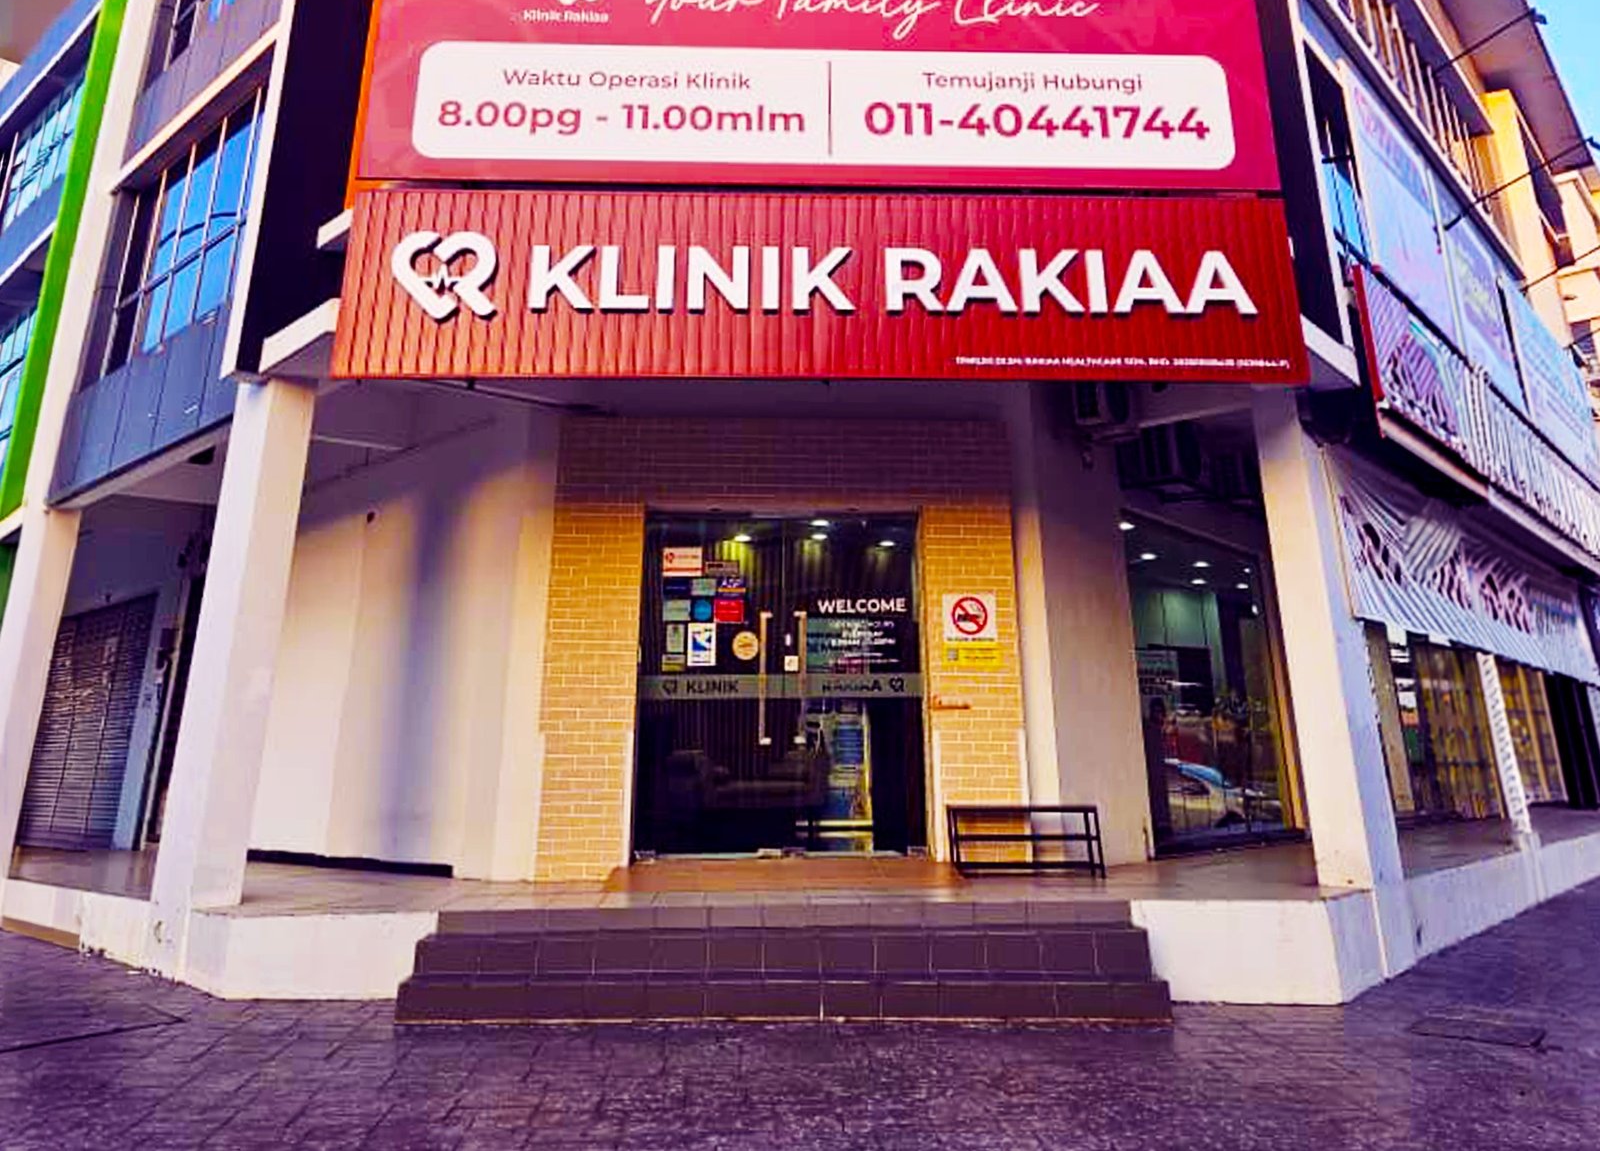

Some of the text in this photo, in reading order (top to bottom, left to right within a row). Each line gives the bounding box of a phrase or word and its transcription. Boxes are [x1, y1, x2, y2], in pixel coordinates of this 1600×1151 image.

[503, 69, 751, 90] Waktu Operasi Klinik
[922, 72, 1143, 95] Temujanji Hubungi
[438, 101, 582, 136] 8.00pg
[621, 104, 805, 132] 11.00mlm
[864, 102, 1211, 140] 011-40441744
[530, 245, 1259, 315] KLINIK RAKIAA
[817, 598, 907, 614] WELCOME
[686, 680, 739, 694] KLINIK
